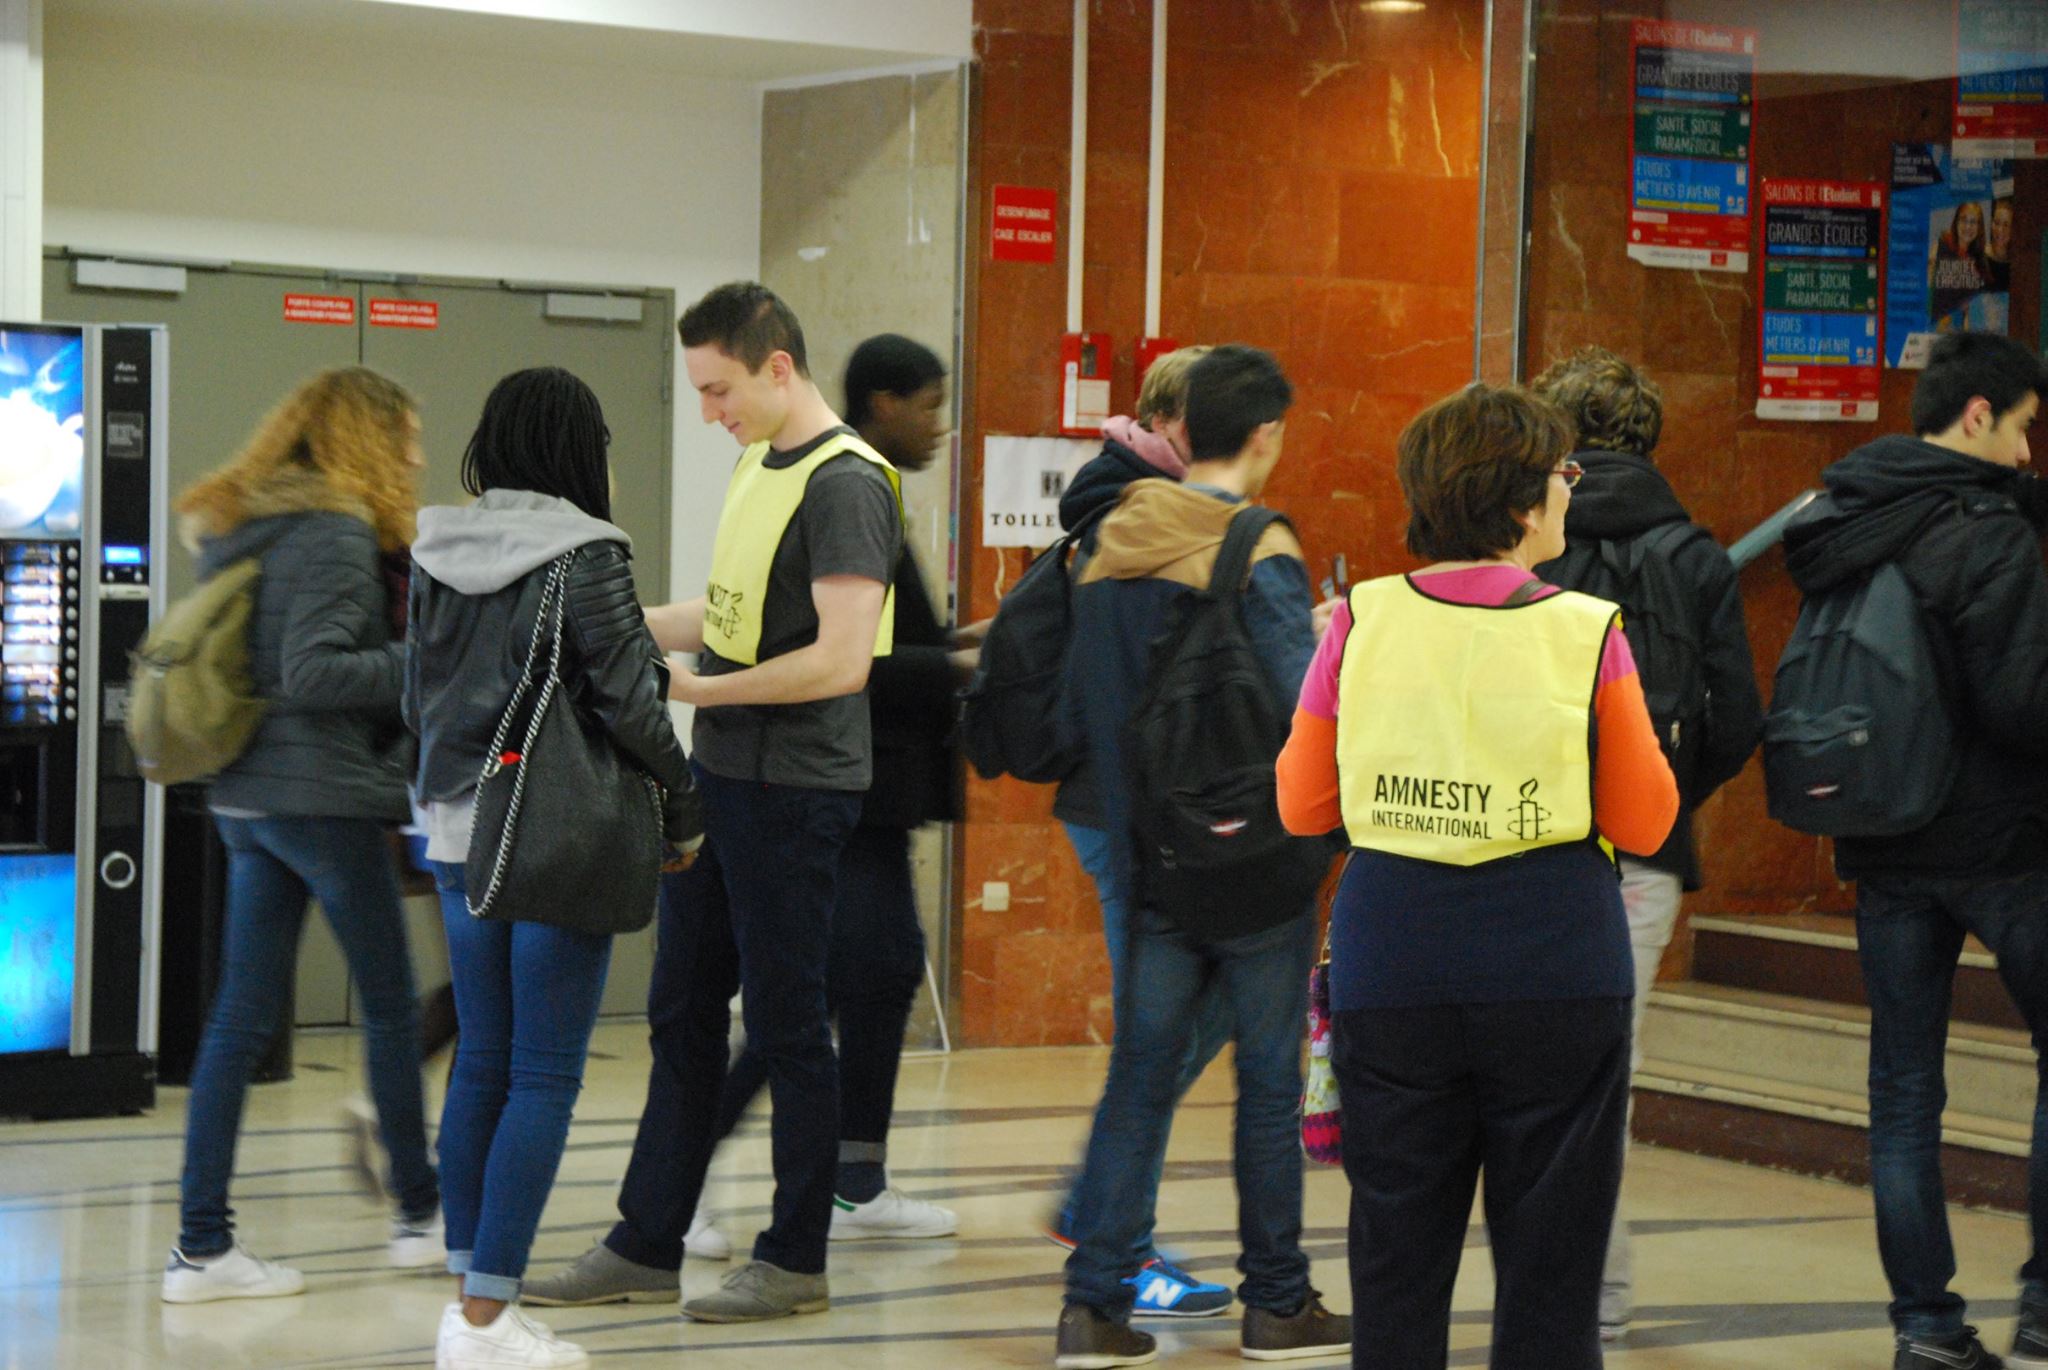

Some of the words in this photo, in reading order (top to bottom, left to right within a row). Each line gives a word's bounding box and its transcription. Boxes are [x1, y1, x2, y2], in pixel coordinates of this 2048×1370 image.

[1765, 183, 1803, 202] SALONS
[1805, 185, 1817, 202] DE
[1767, 223, 1821, 244] GRANDES
[1819, 272, 1851, 290] SOCIAL
[991, 513, 1056, 528] TOILE
[1374, 774, 1492, 814] AMNESTY
[1372, 809, 1493, 840] INTERNATIONAL
